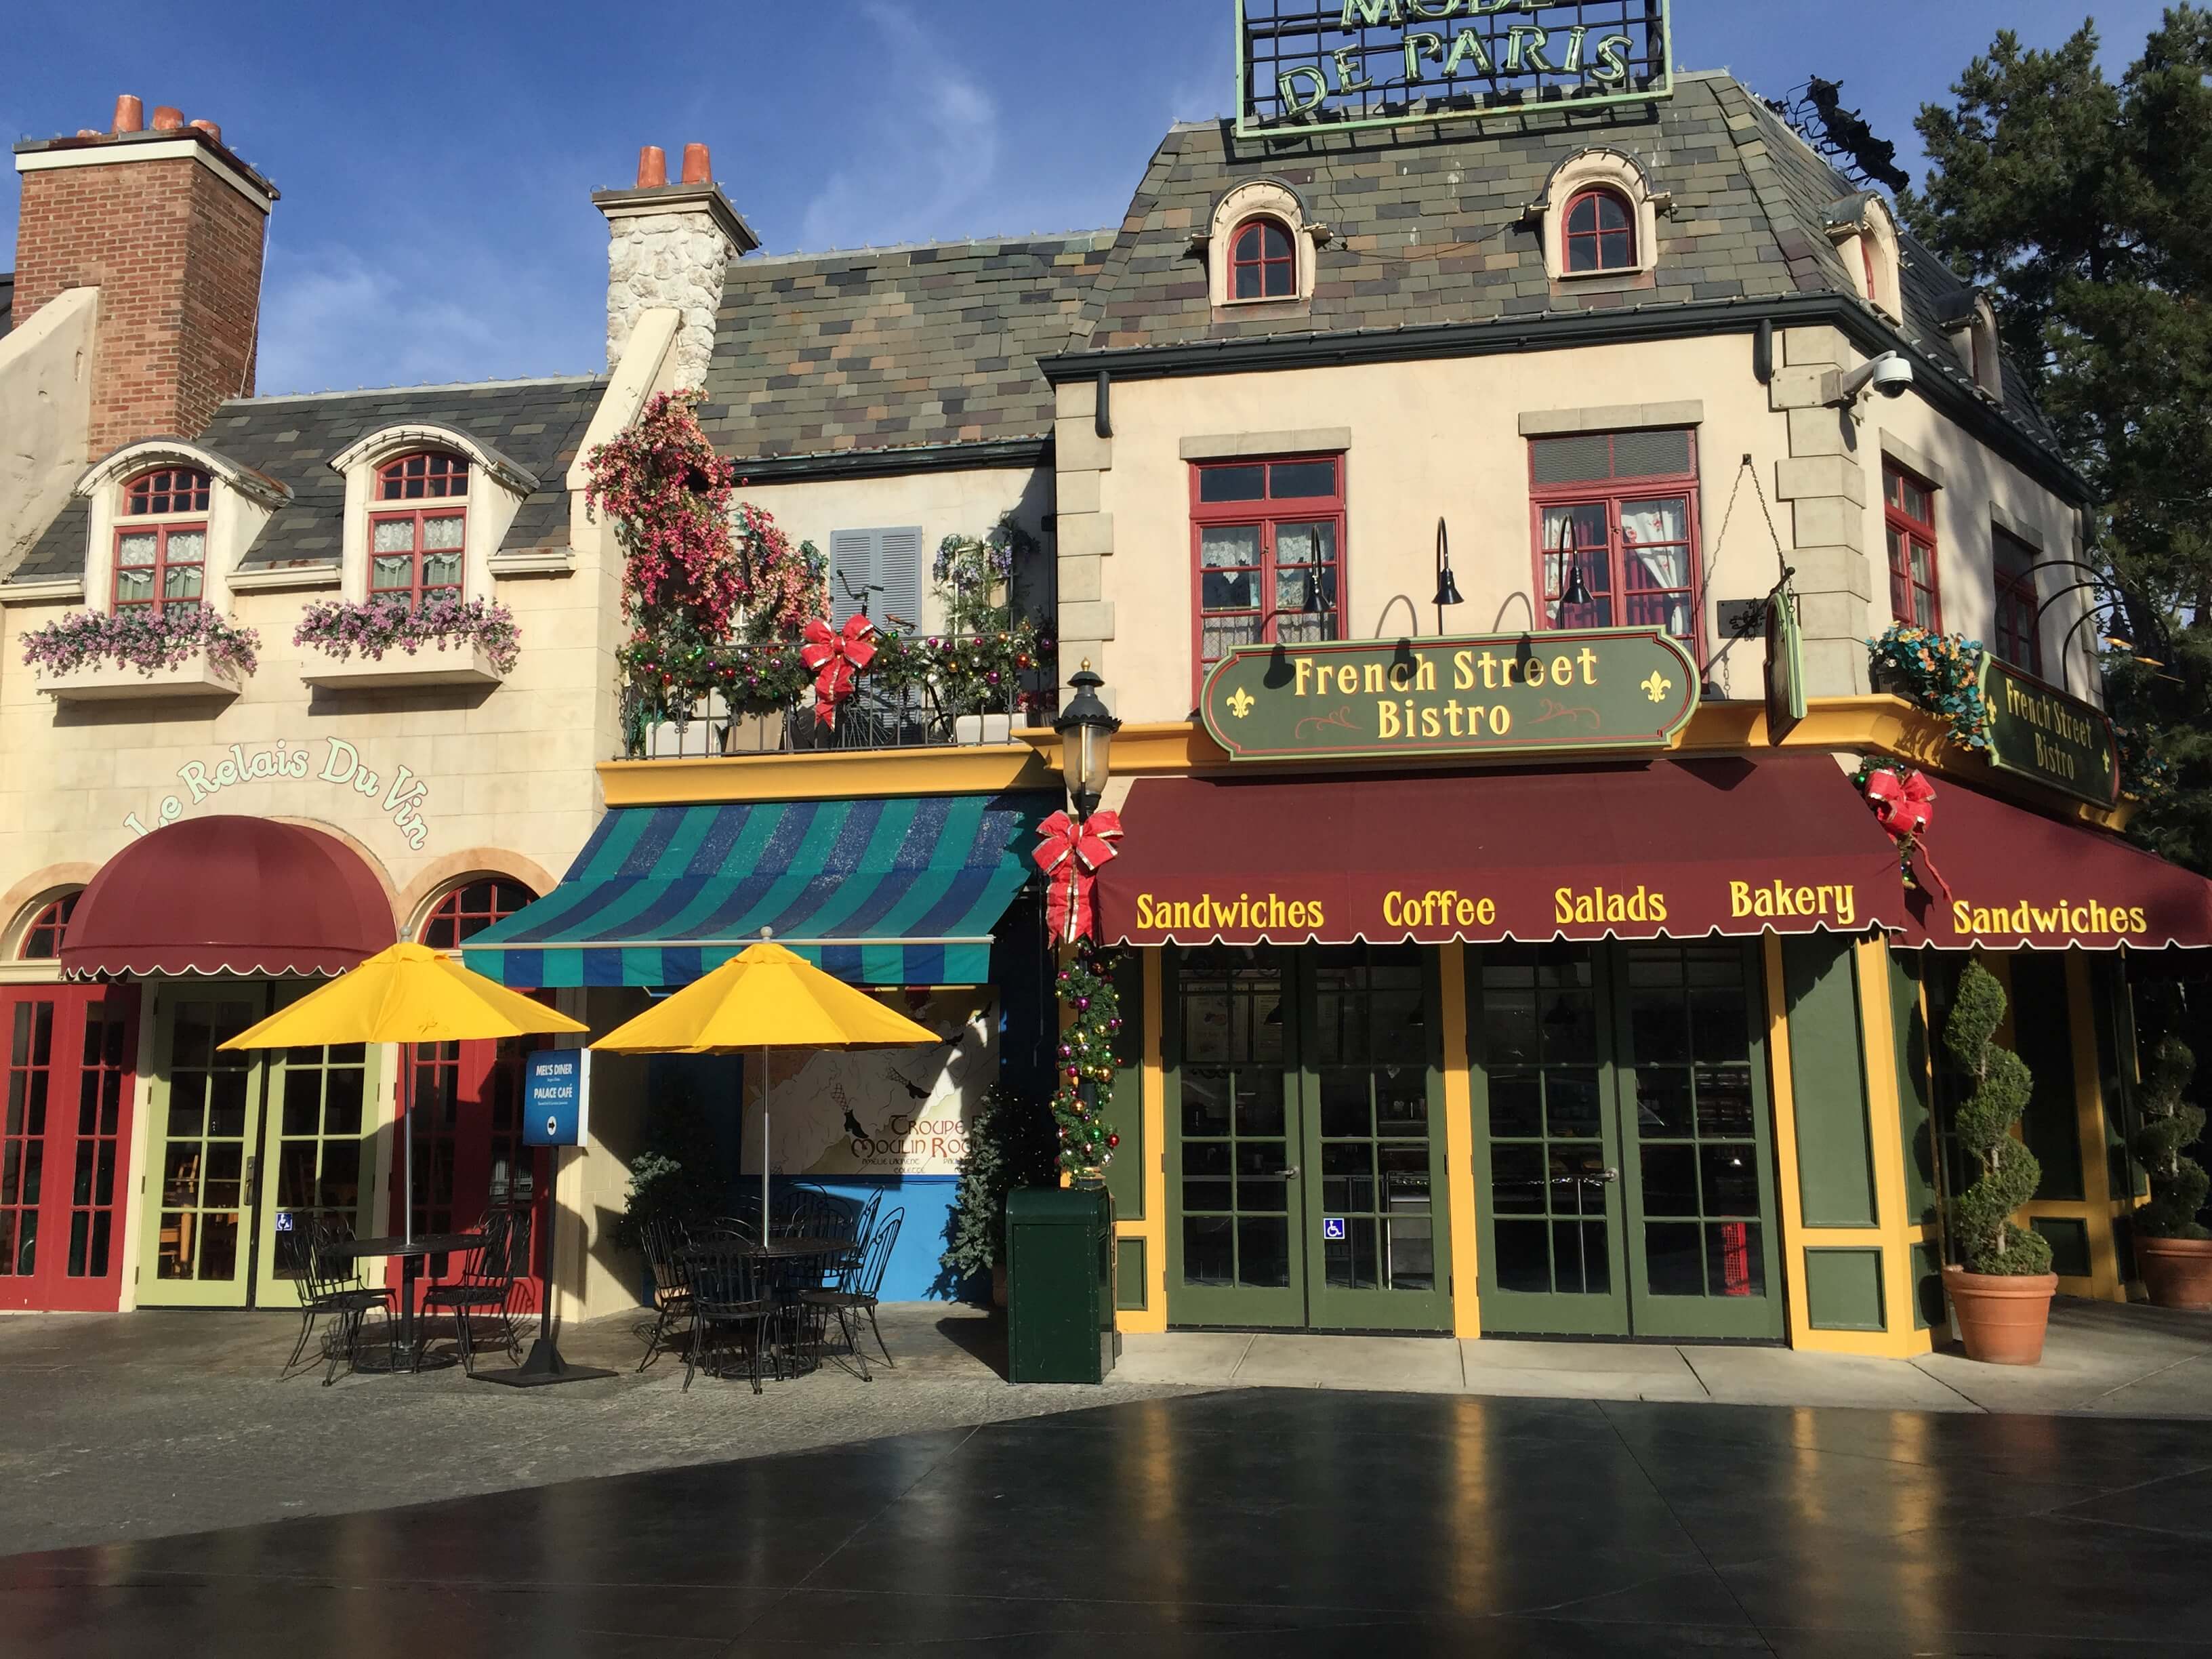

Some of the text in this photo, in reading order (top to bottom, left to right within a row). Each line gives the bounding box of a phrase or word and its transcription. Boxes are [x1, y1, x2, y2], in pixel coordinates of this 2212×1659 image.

[1277, 25, 1634, 118] DE PARIS
[1294, 647, 1599, 696] French Street
[1377, 699, 1512, 739] Bistro
[2005, 678, 2093, 750] French Street
[2034, 733, 2074, 781] Bistro
[123, 736, 428, 851] Le Relais Du Vin
[1136, 880, 1856, 928] Sandwiches Coffee Salads Bakery
[1952, 899, 2148, 934] Sandwiches
[533, 1084, 573, 1099] PALACE CAFÉ
[554, 1063, 573, 1075] DINER
